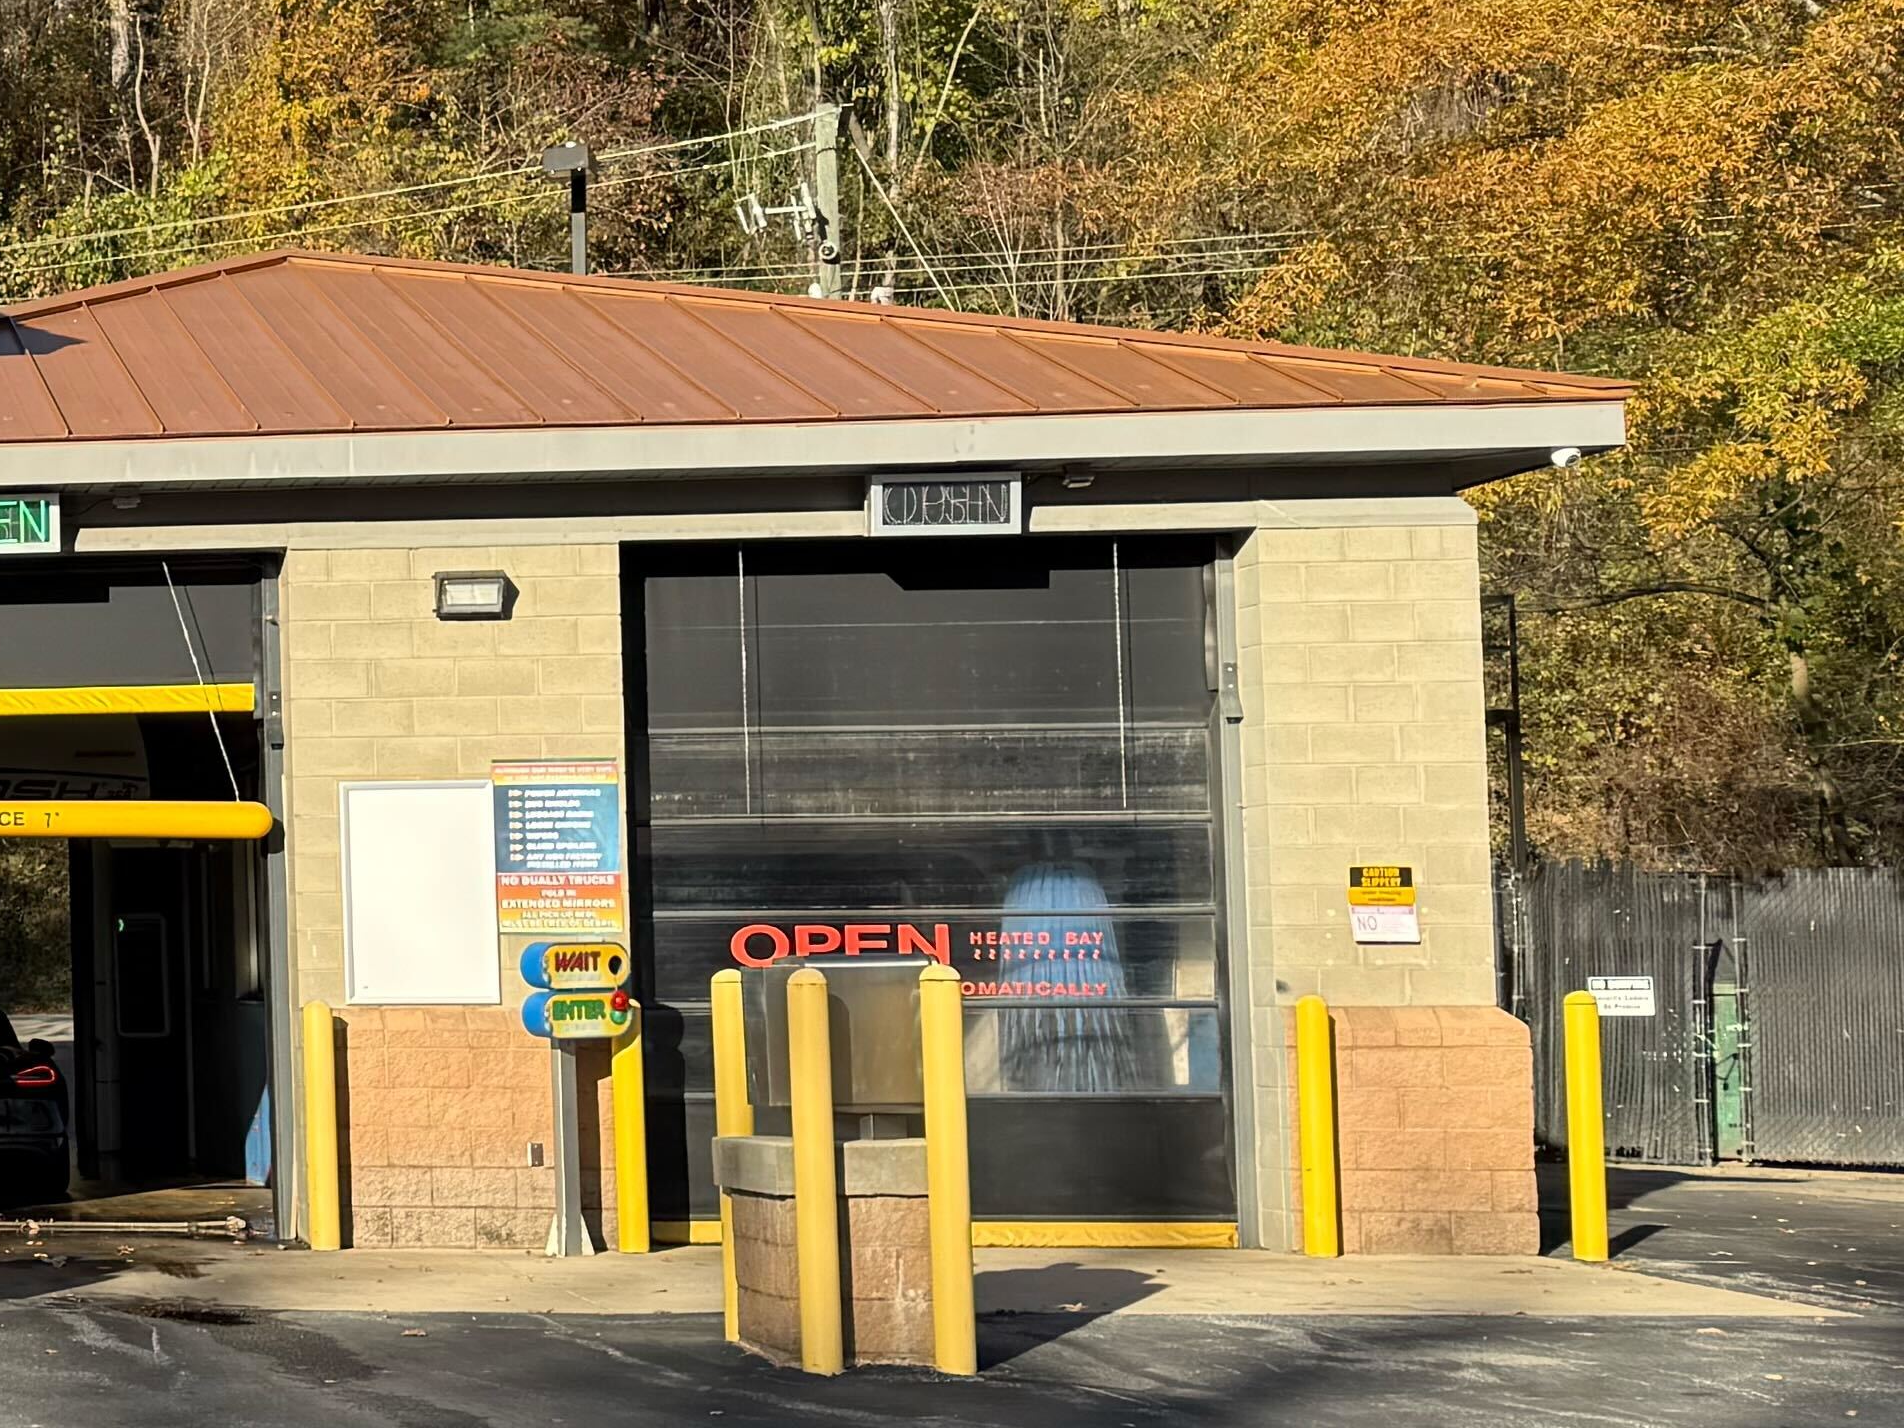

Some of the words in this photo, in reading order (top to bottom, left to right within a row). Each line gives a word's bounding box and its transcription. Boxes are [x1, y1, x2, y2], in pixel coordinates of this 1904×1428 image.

[1362, 868, 1400, 876] CAUTION
[501, 875, 519, 886] NO
[522, 875, 565, 886] DUALLY
[568, 875, 615, 885] TRUCKS
[501, 899, 560, 908] EXTENDED
[563, 899, 616, 908] MIRRORS
[1357, 915, 1378, 931] NO
[969, 931, 1050, 945] HEATED
[1065, 931, 1104, 945] BAY
[730, 924, 950, 968] OPEN
[554, 951, 601, 972] WAIT
[960, 981, 1108, 996] OMATICALLY
[552, 999, 606, 1021] ENTER
